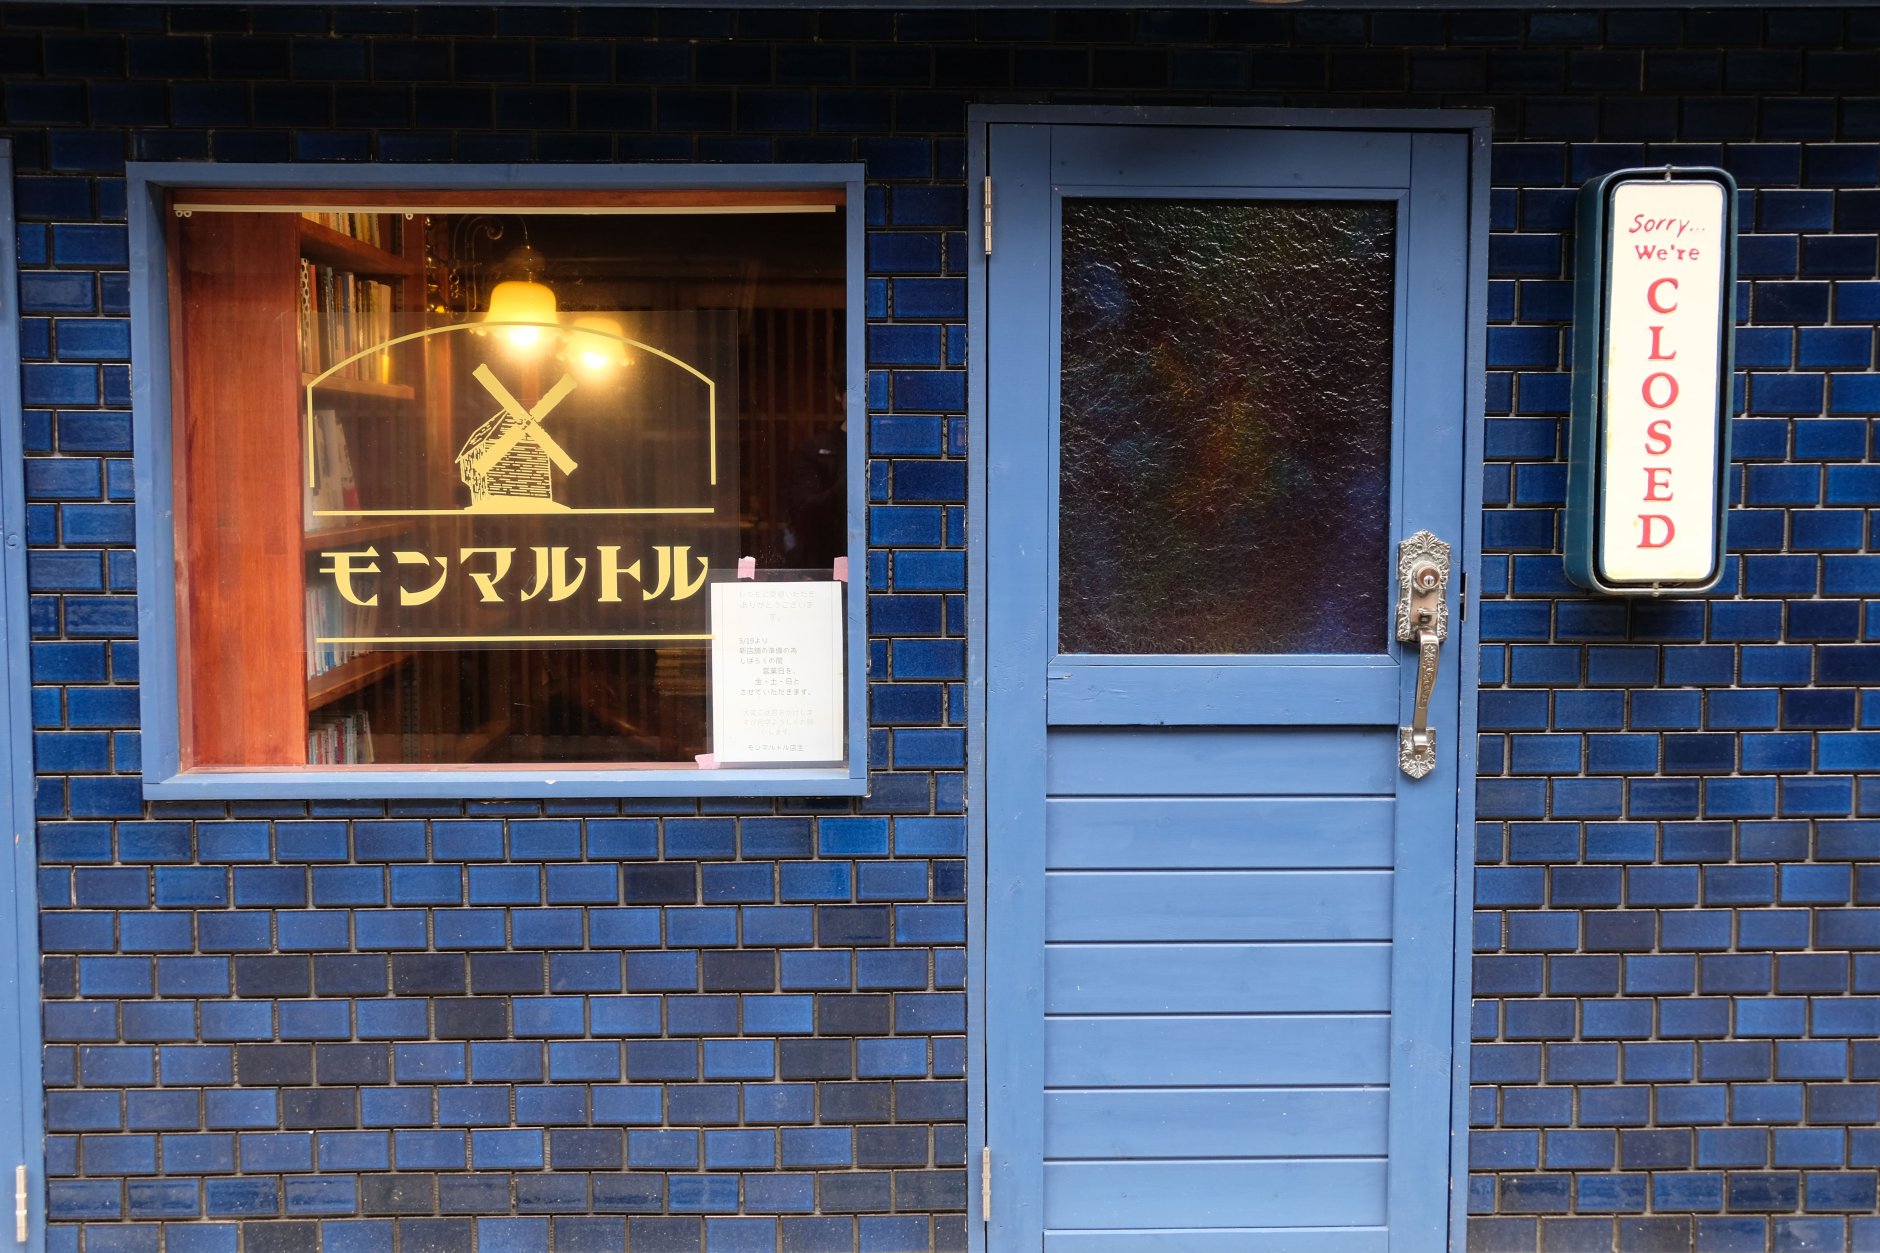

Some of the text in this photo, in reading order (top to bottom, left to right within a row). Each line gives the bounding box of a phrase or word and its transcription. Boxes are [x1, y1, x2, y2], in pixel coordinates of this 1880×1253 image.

[1628, 213, 1705, 237] Sorry...
[1634, 244, 1700, 261] We're
[1636, 277, 1680, 548] CLOSED
[319, 545, 709, 607] モンマルトル
[739, 637, 768, 645] 5/19より
[739, 647, 798, 655] 新店舗の準備の為
[740, 657, 783, 665] しばらくの間
[740, 688, 812, 696] させていただきます。
[748, 744, 805, 752] モンマルトル店主
